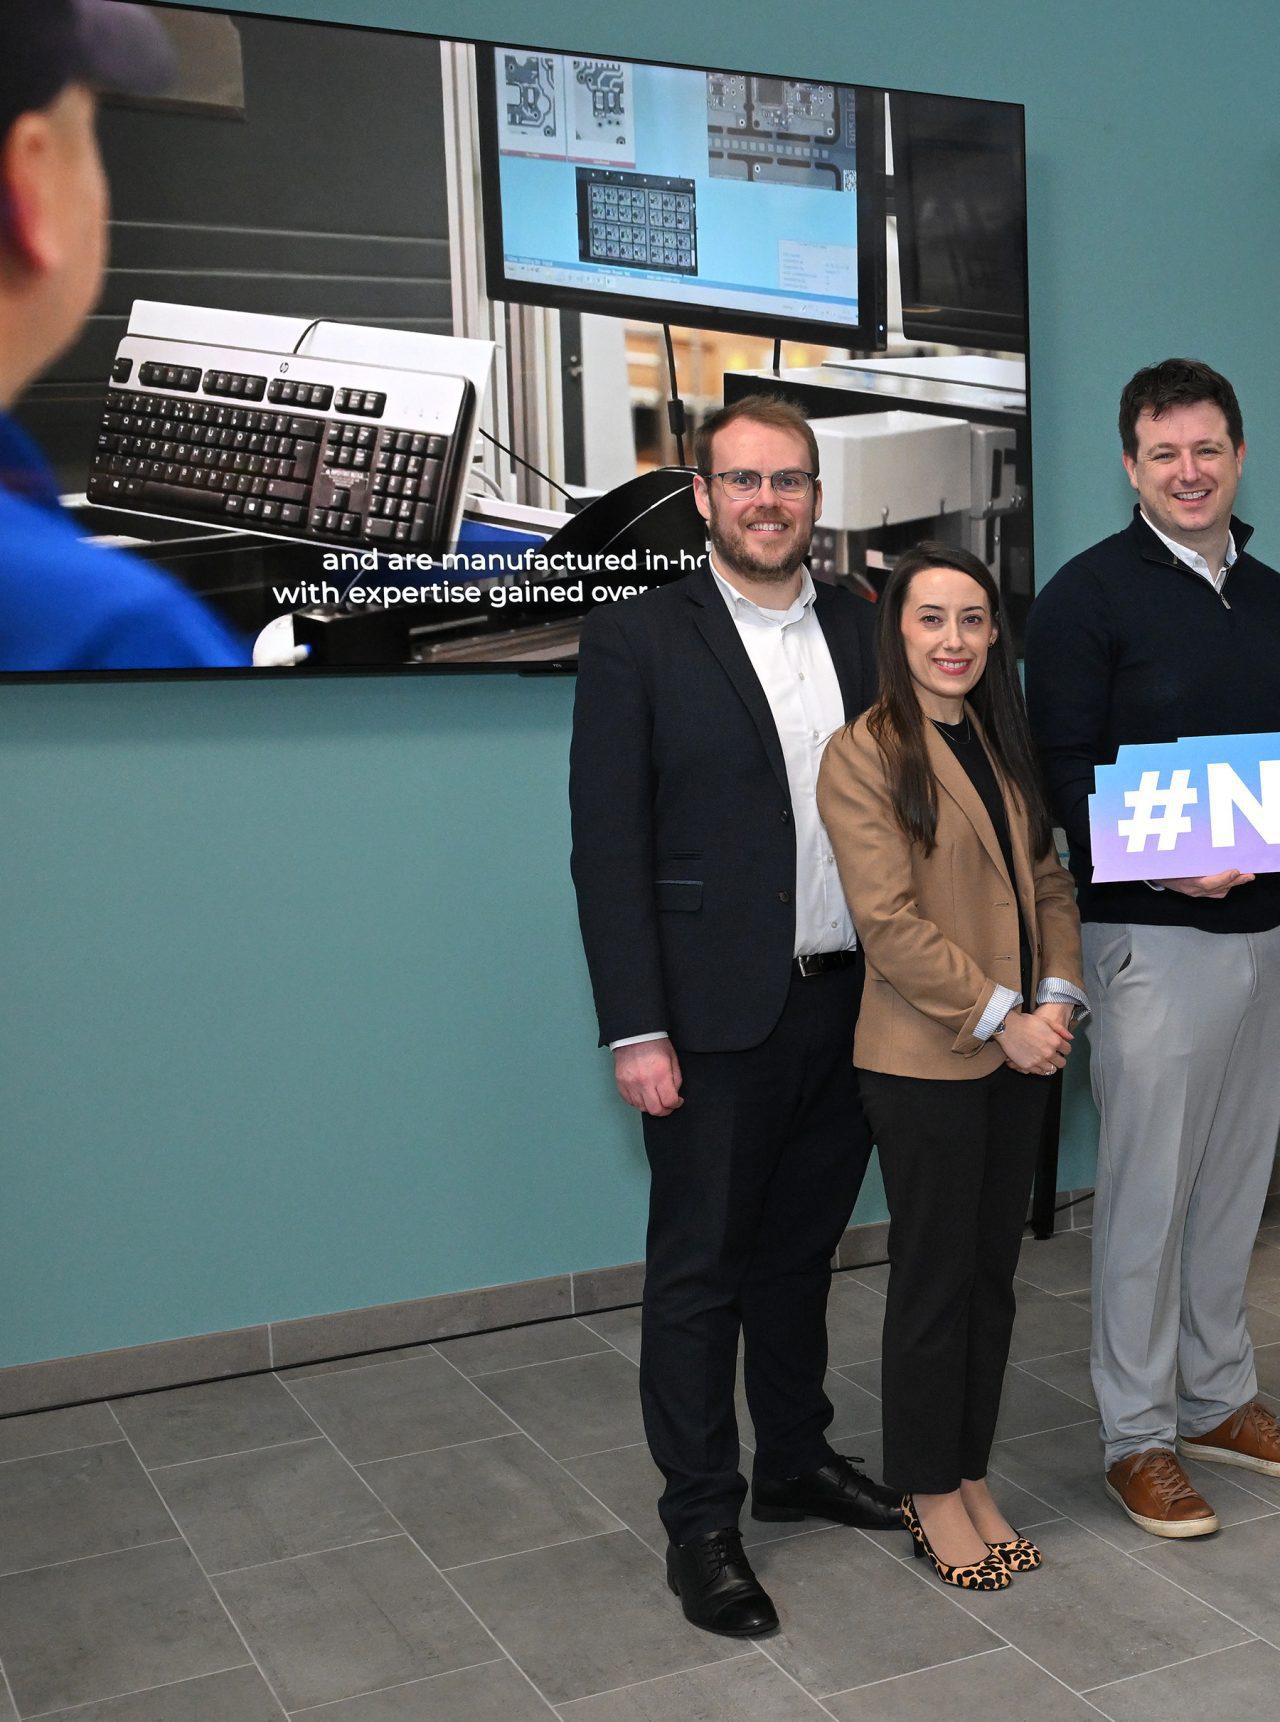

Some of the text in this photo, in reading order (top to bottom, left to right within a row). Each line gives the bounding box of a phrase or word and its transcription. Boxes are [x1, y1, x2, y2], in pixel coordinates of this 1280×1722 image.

[322, 548, 379, 571] and
[387, 554, 433, 571] are
[442, 548, 637, 572] manufactured
[272, 580, 340, 604] with
[349, 580, 482, 609] expertise
[489, 580, 584, 609] gained
